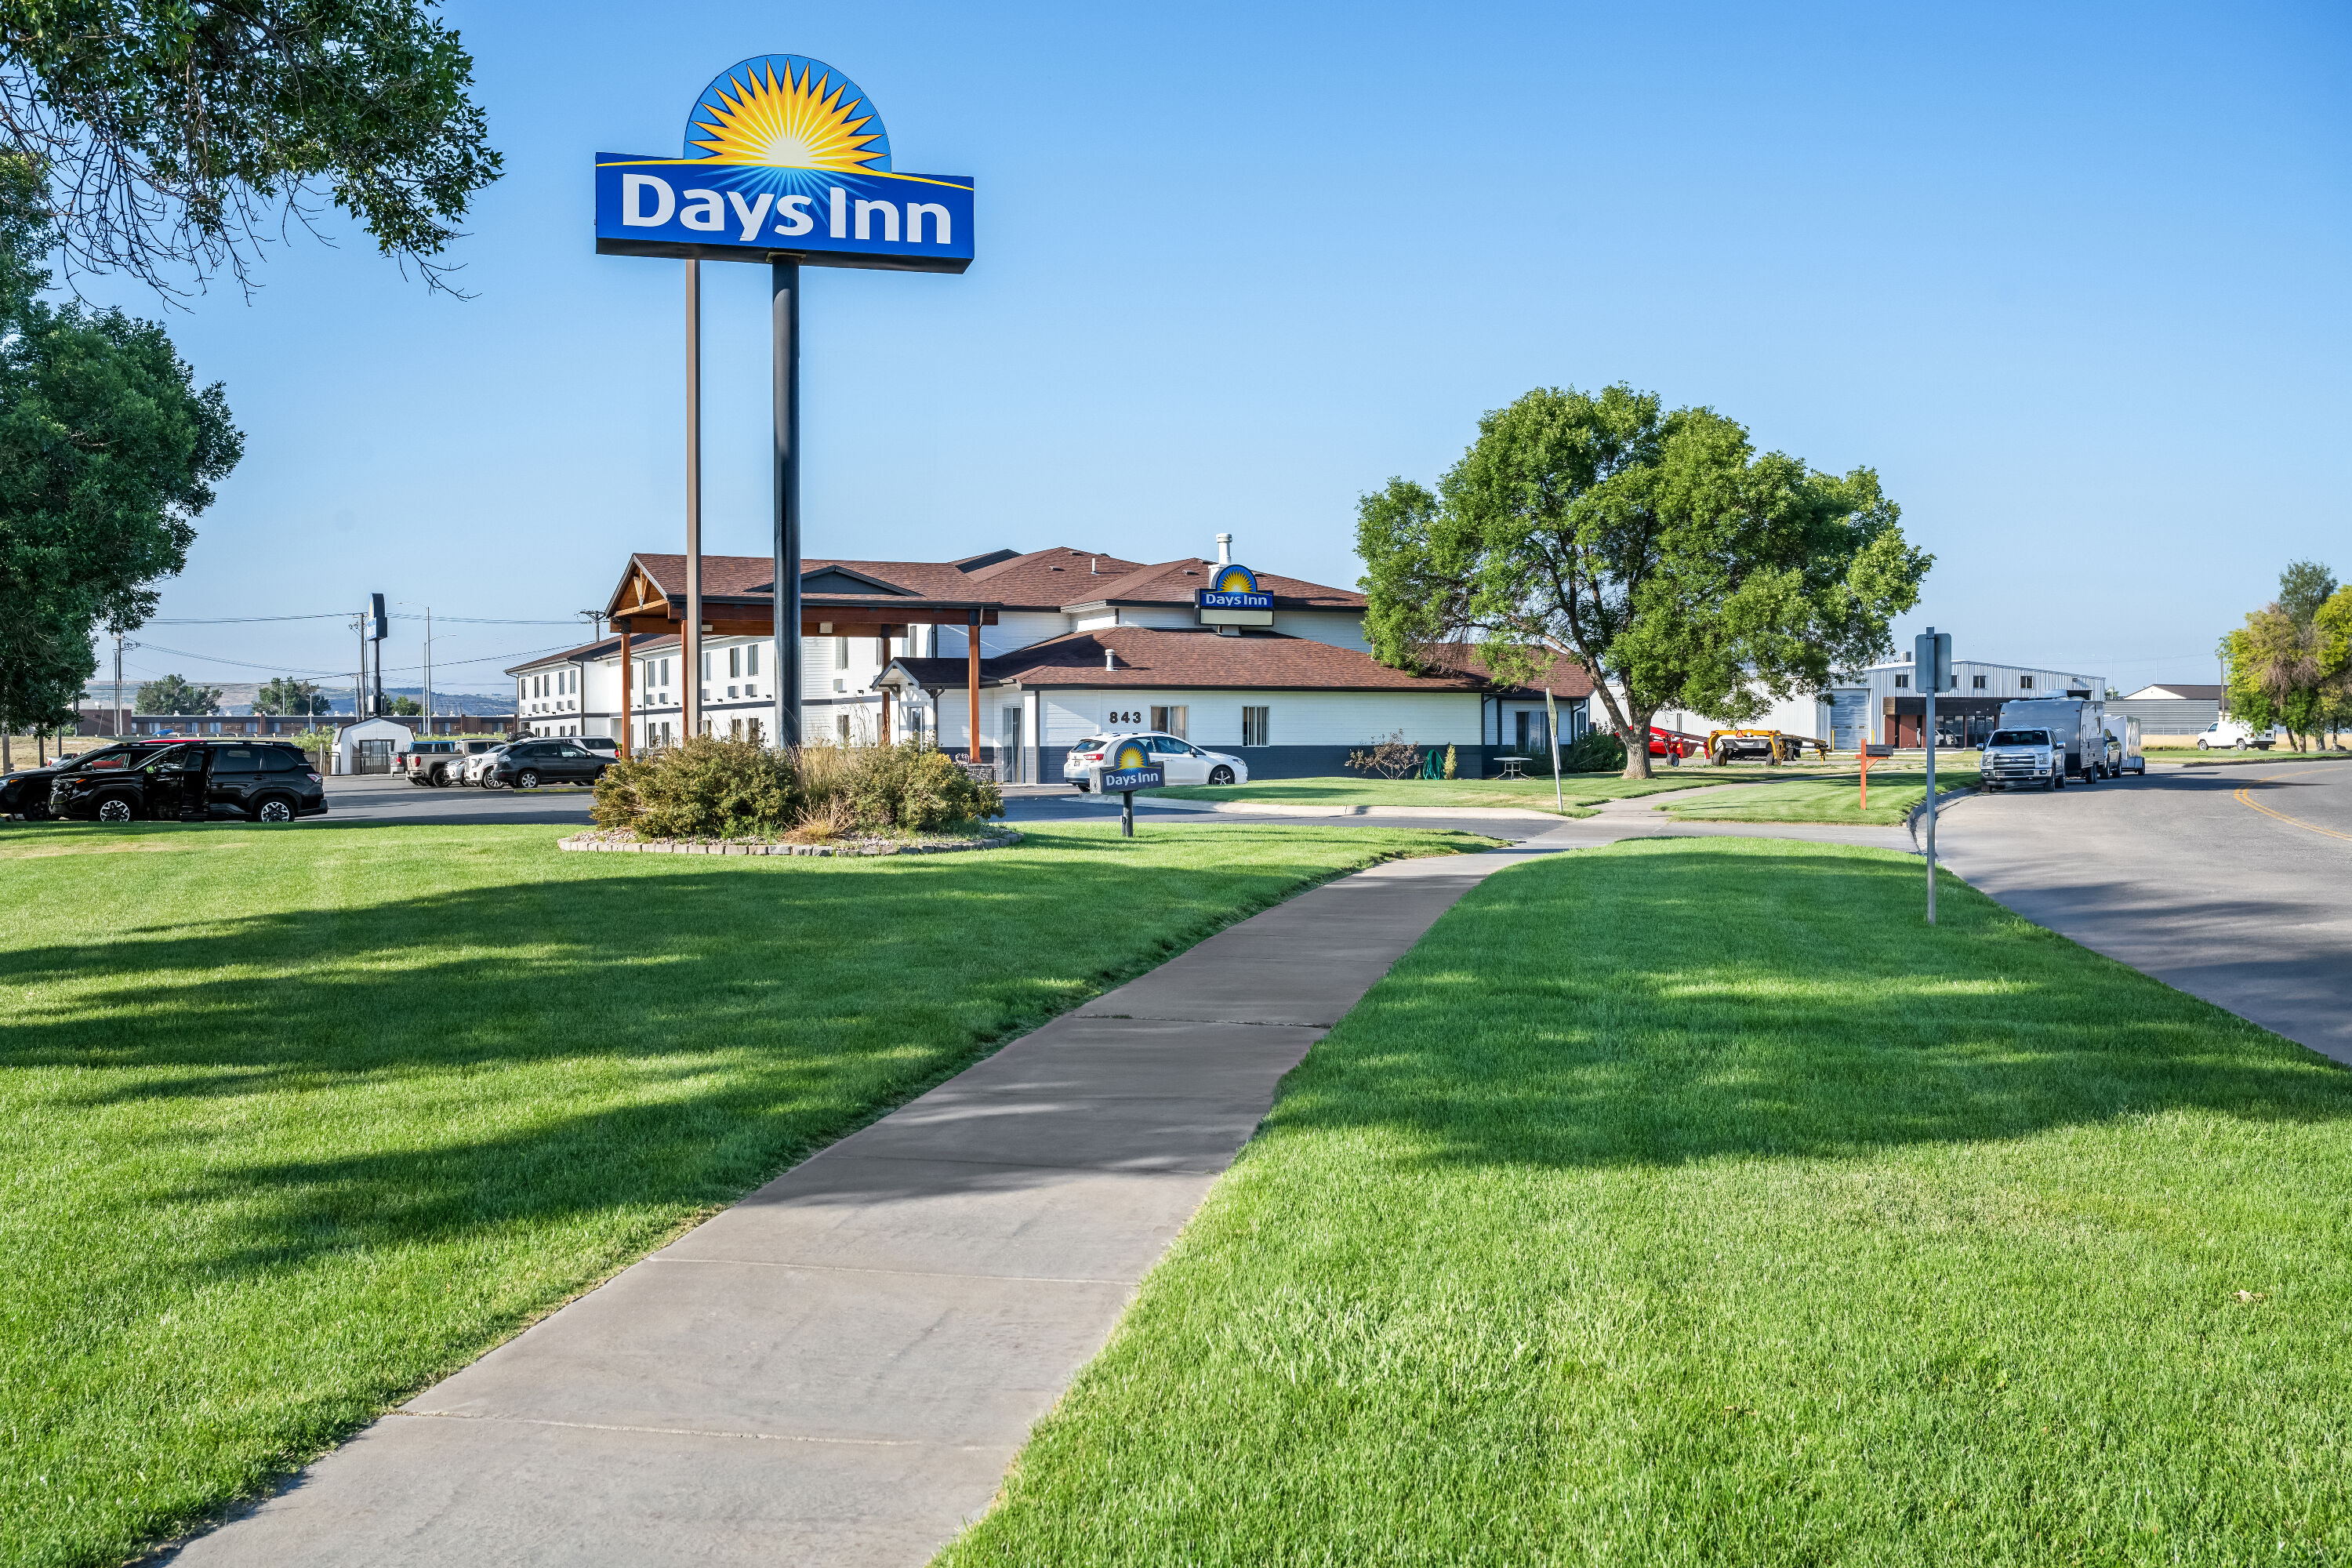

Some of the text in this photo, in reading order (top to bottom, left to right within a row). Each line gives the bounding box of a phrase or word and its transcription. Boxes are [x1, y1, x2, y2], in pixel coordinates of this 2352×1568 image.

[622, 173, 951, 244] Days Inn
[1206, 593, 1268, 606] Days Inn
[1109, 711, 1142, 724] 843
[1105, 772, 1159, 786] Days Inn
